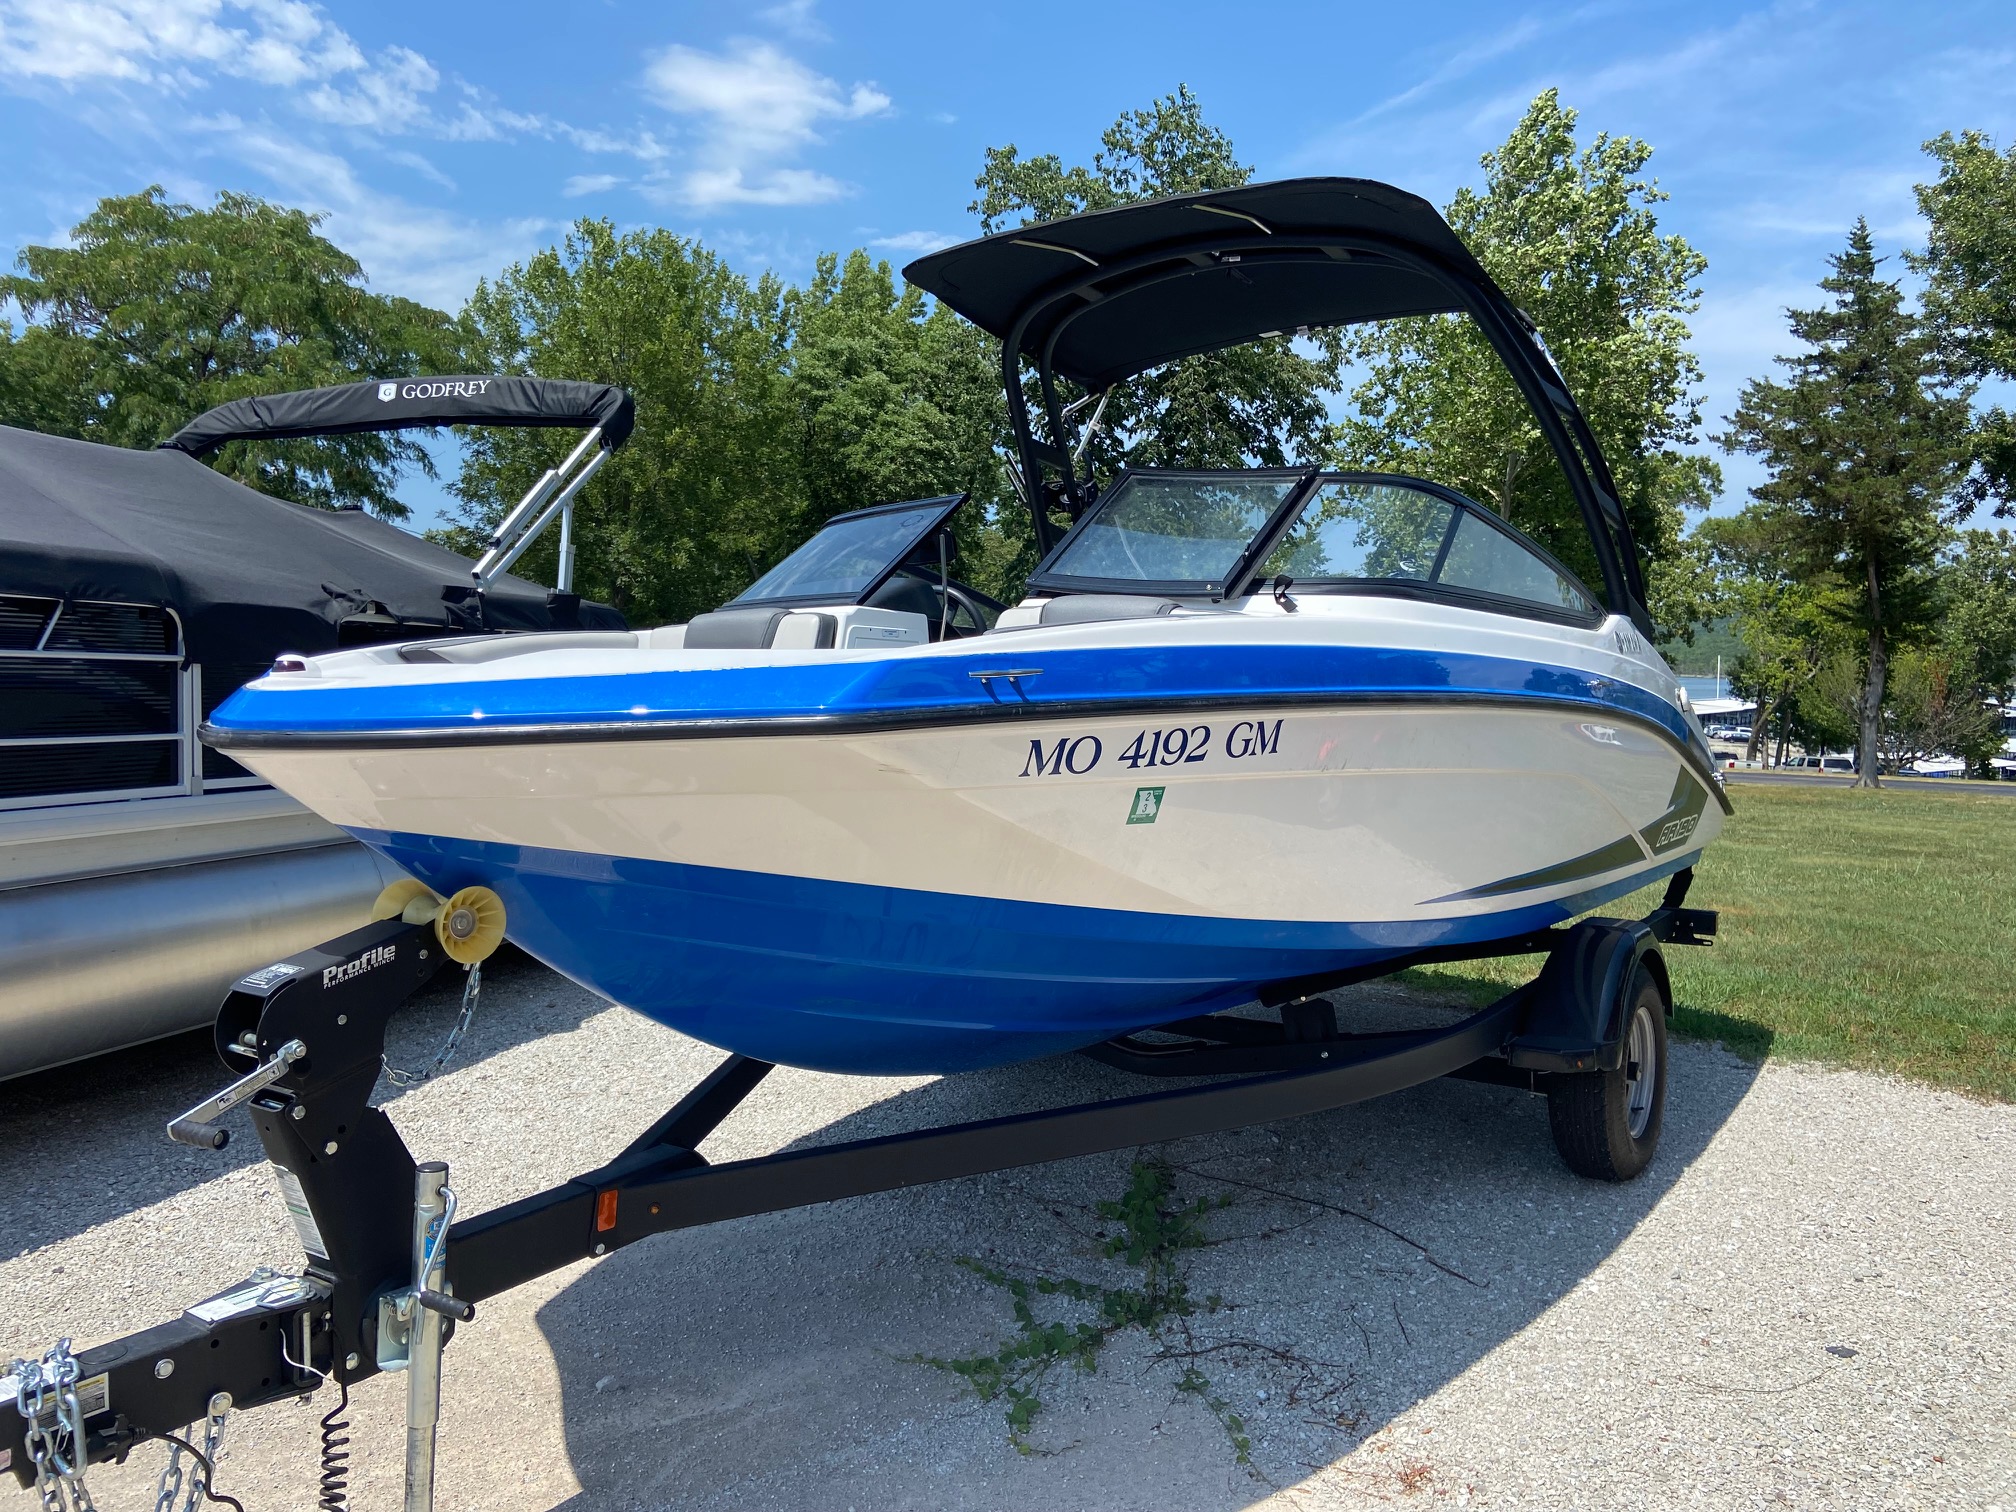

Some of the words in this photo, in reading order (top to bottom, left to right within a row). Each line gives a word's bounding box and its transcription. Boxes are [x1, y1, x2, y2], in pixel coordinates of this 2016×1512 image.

[402, 379, 492, 399] GODFREY
[1018, 735, 1103, 777] MO
[1117, 725, 1211, 769] 4192
[1225, 718, 1284, 758] GM
[322, 945, 396, 985] Profile
[323, 964, 371, 990] PERFORMANCE
[373, 955, 395, 968] WINCH
